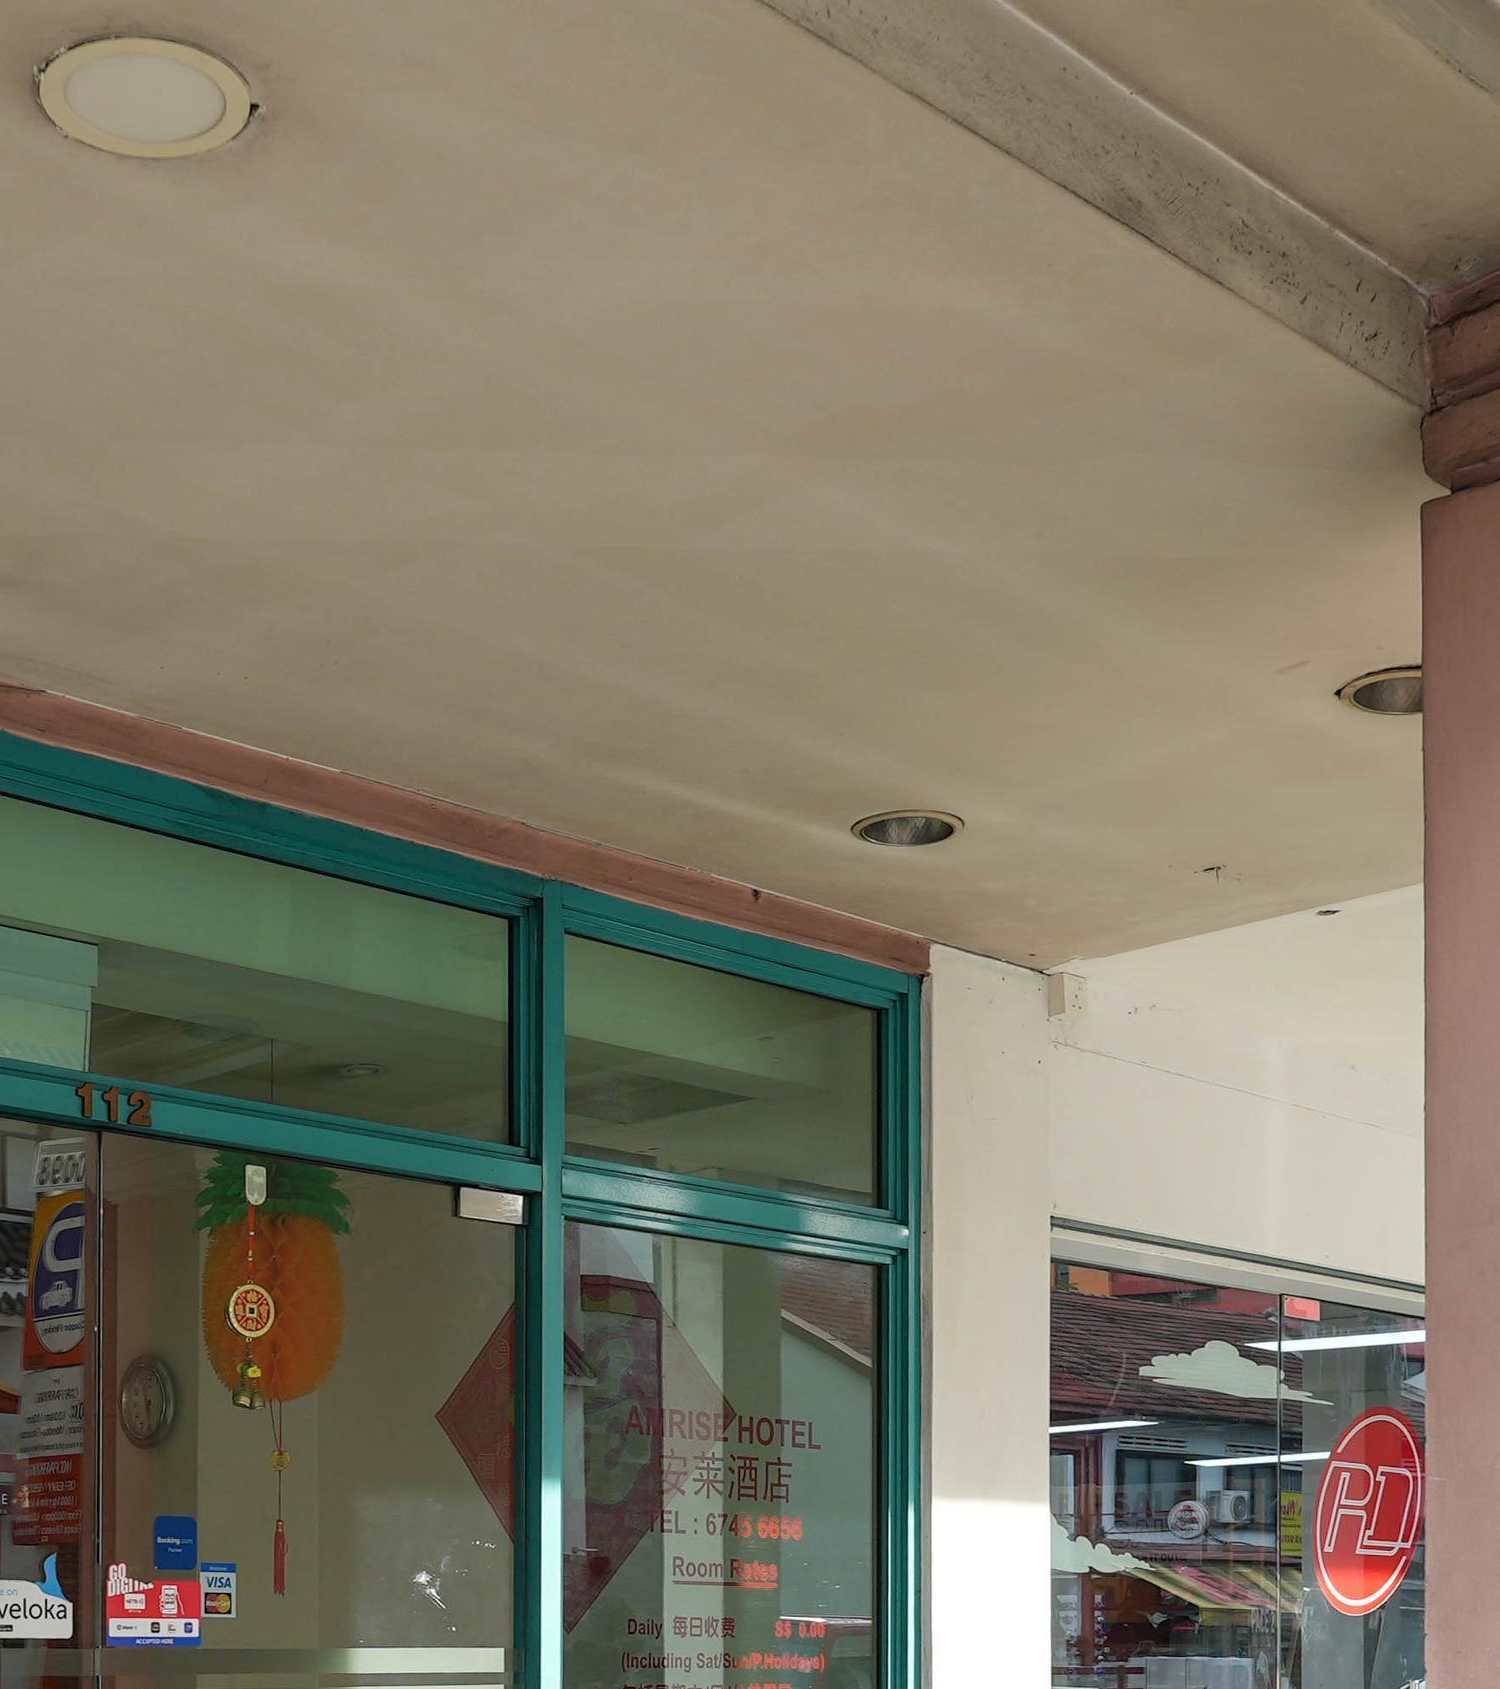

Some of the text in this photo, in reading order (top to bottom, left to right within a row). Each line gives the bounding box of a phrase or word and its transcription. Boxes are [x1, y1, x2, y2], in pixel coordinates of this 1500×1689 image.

[76, 1081, 153, 1127] 112
[625, 1405, 822, 1451] AMRISE HOTEL
[659, 1448, 793, 1503] 安莱酒店
[706, 1513, 753, 1538] 6745
[108, 1563, 127, 1579] GO
[672, 1556, 778, 1580] Room Rates
[6, 1588, 19, 1596] on
[206, 1576, 232, 1589] VISA
[627, 1618, 663, 1640] Daily
[673, 1617, 738, 1638] 每日收费
[621, 1650, 691, 1673] (Including
